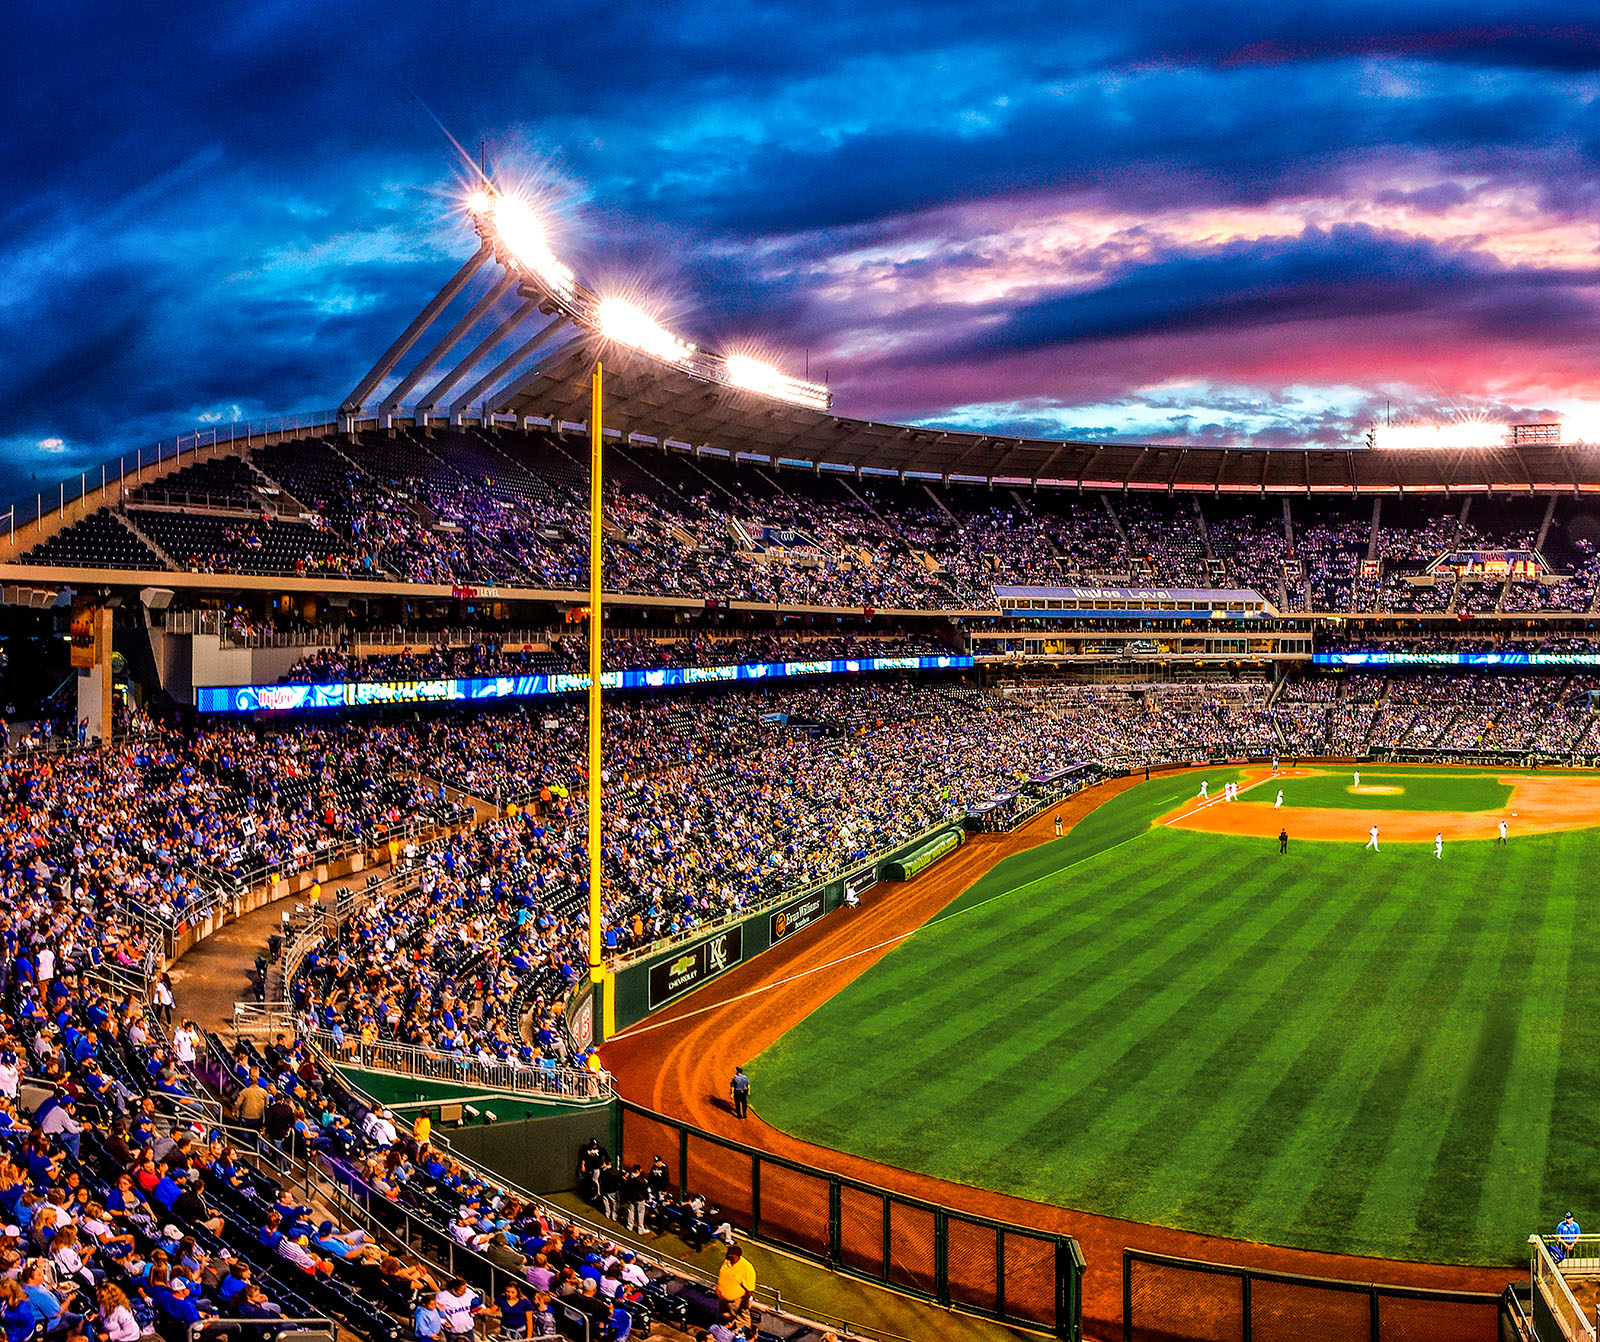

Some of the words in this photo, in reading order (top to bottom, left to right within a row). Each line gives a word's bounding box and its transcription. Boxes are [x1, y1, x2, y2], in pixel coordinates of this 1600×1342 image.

[480, 588, 500, 598] LEVEL
[1127, 589, 1172, 599] Level
[710, 935, 727, 969] KC
[668, 970, 698, 990] CHEVROLET
